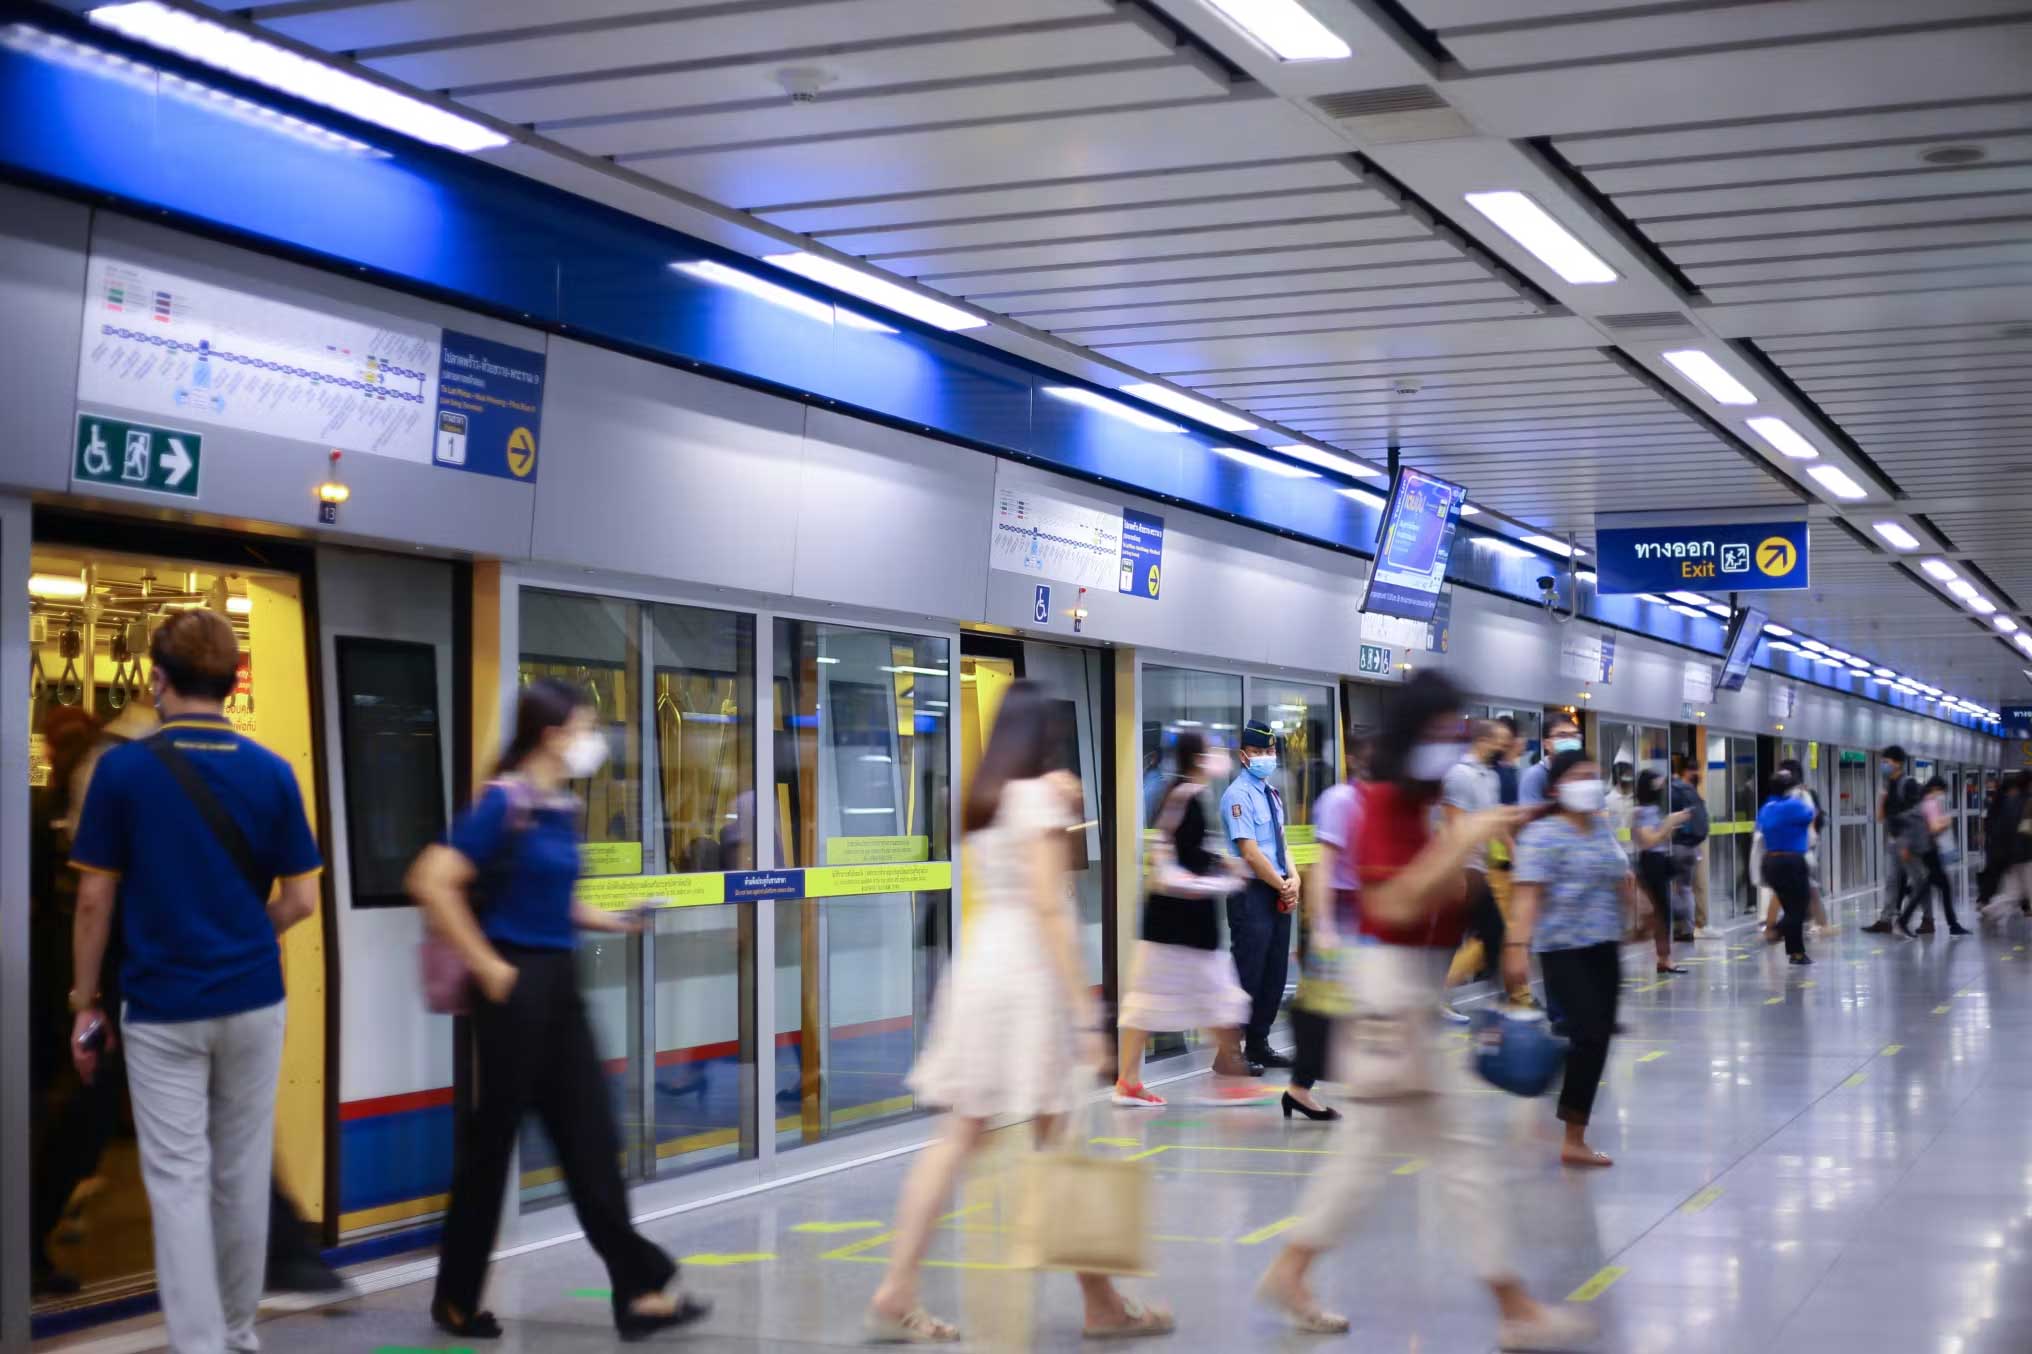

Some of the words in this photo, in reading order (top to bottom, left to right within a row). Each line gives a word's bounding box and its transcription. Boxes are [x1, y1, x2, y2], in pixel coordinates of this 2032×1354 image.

[1634, 540, 1715, 559] ทางออก
[1681, 560, 1716, 578] Exit
